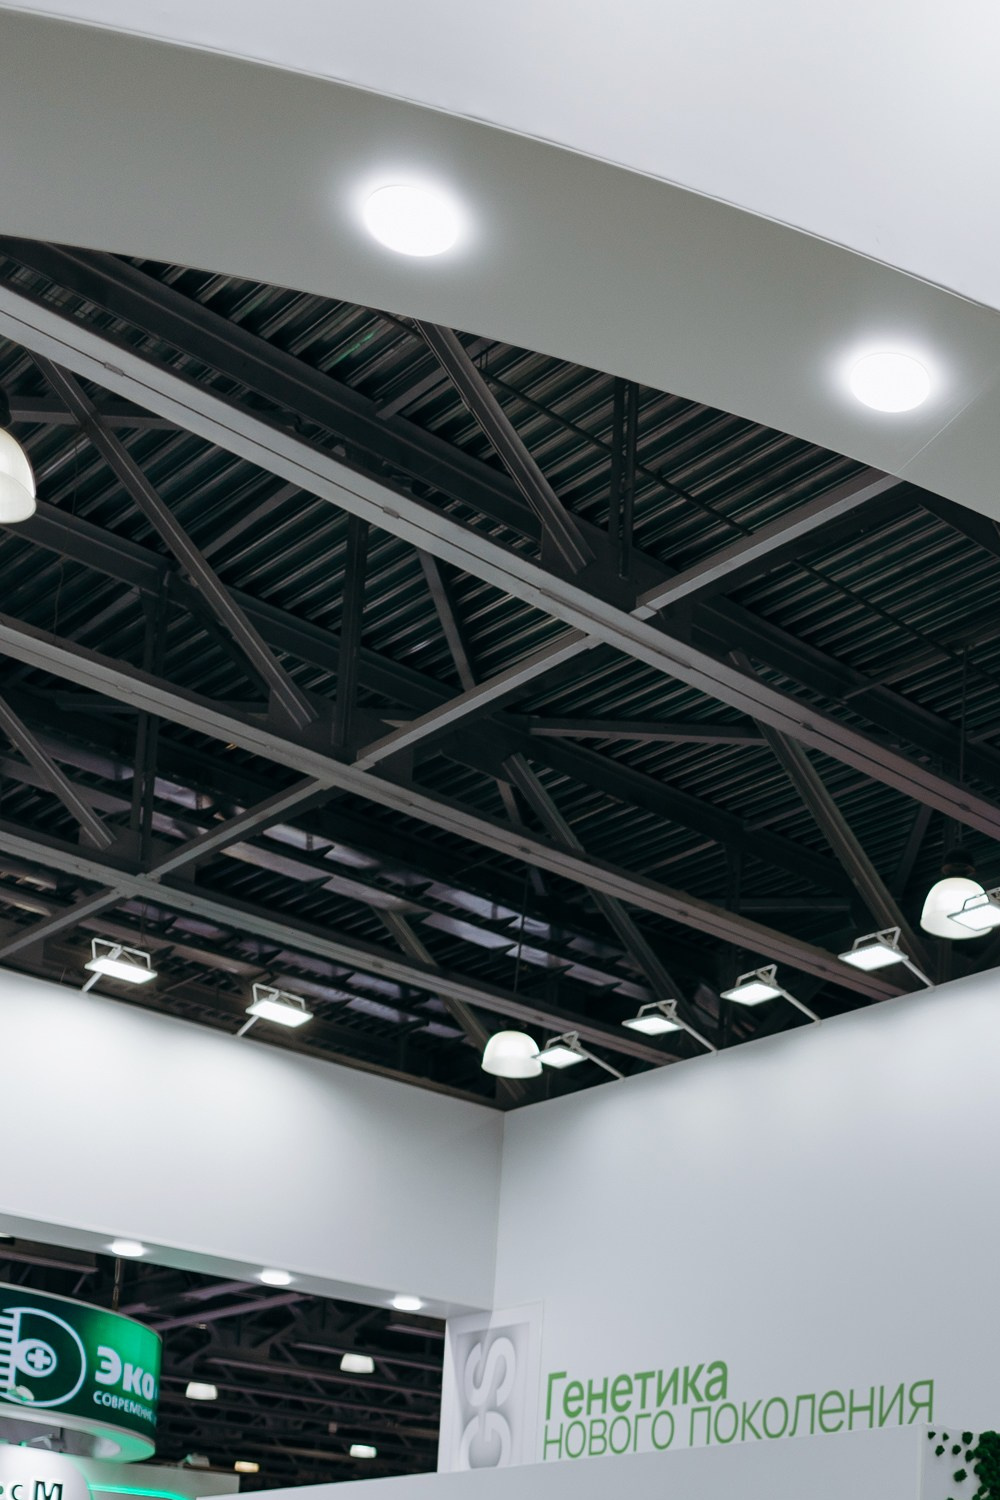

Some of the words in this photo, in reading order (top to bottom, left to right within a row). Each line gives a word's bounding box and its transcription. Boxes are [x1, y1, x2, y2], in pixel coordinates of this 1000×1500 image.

[543, 1410, 675, 1460] нового
[689, 1379, 934, 1447] поколения
[545, 1360, 728, 1420] Генетика
